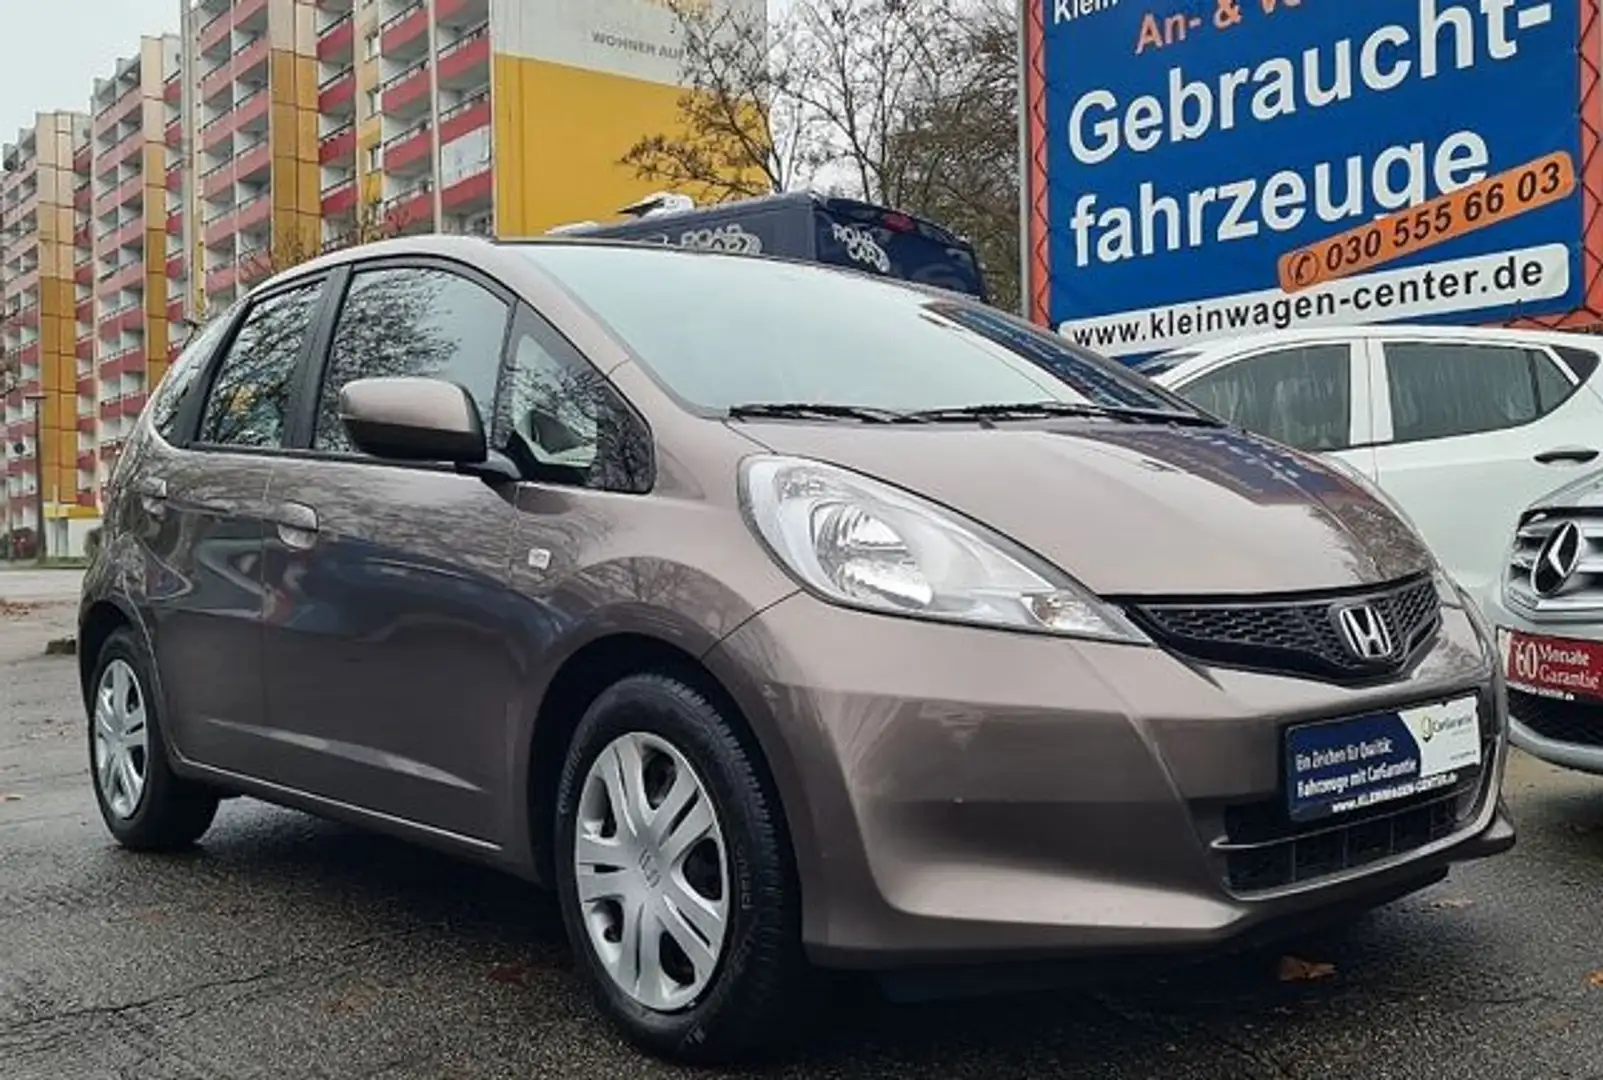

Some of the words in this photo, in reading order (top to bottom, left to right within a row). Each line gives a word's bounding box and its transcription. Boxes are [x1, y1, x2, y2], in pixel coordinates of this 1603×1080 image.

[1134, 14, 1201, 54] An-
[1213, 0, 1241, 29] &
[1068, 0, 1552, 165] Gebraucht-
[1070, 129, 1488, 267] fahrzeuge
[1325, 228, 1381, 272] 030
[1393, 202, 1451, 252] 555
[1464, 183, 1504, 222] 66
[1517, 162, 1560, 203] 03
[1073, 256, 1543, 347] www.kleinwagen-center.de
